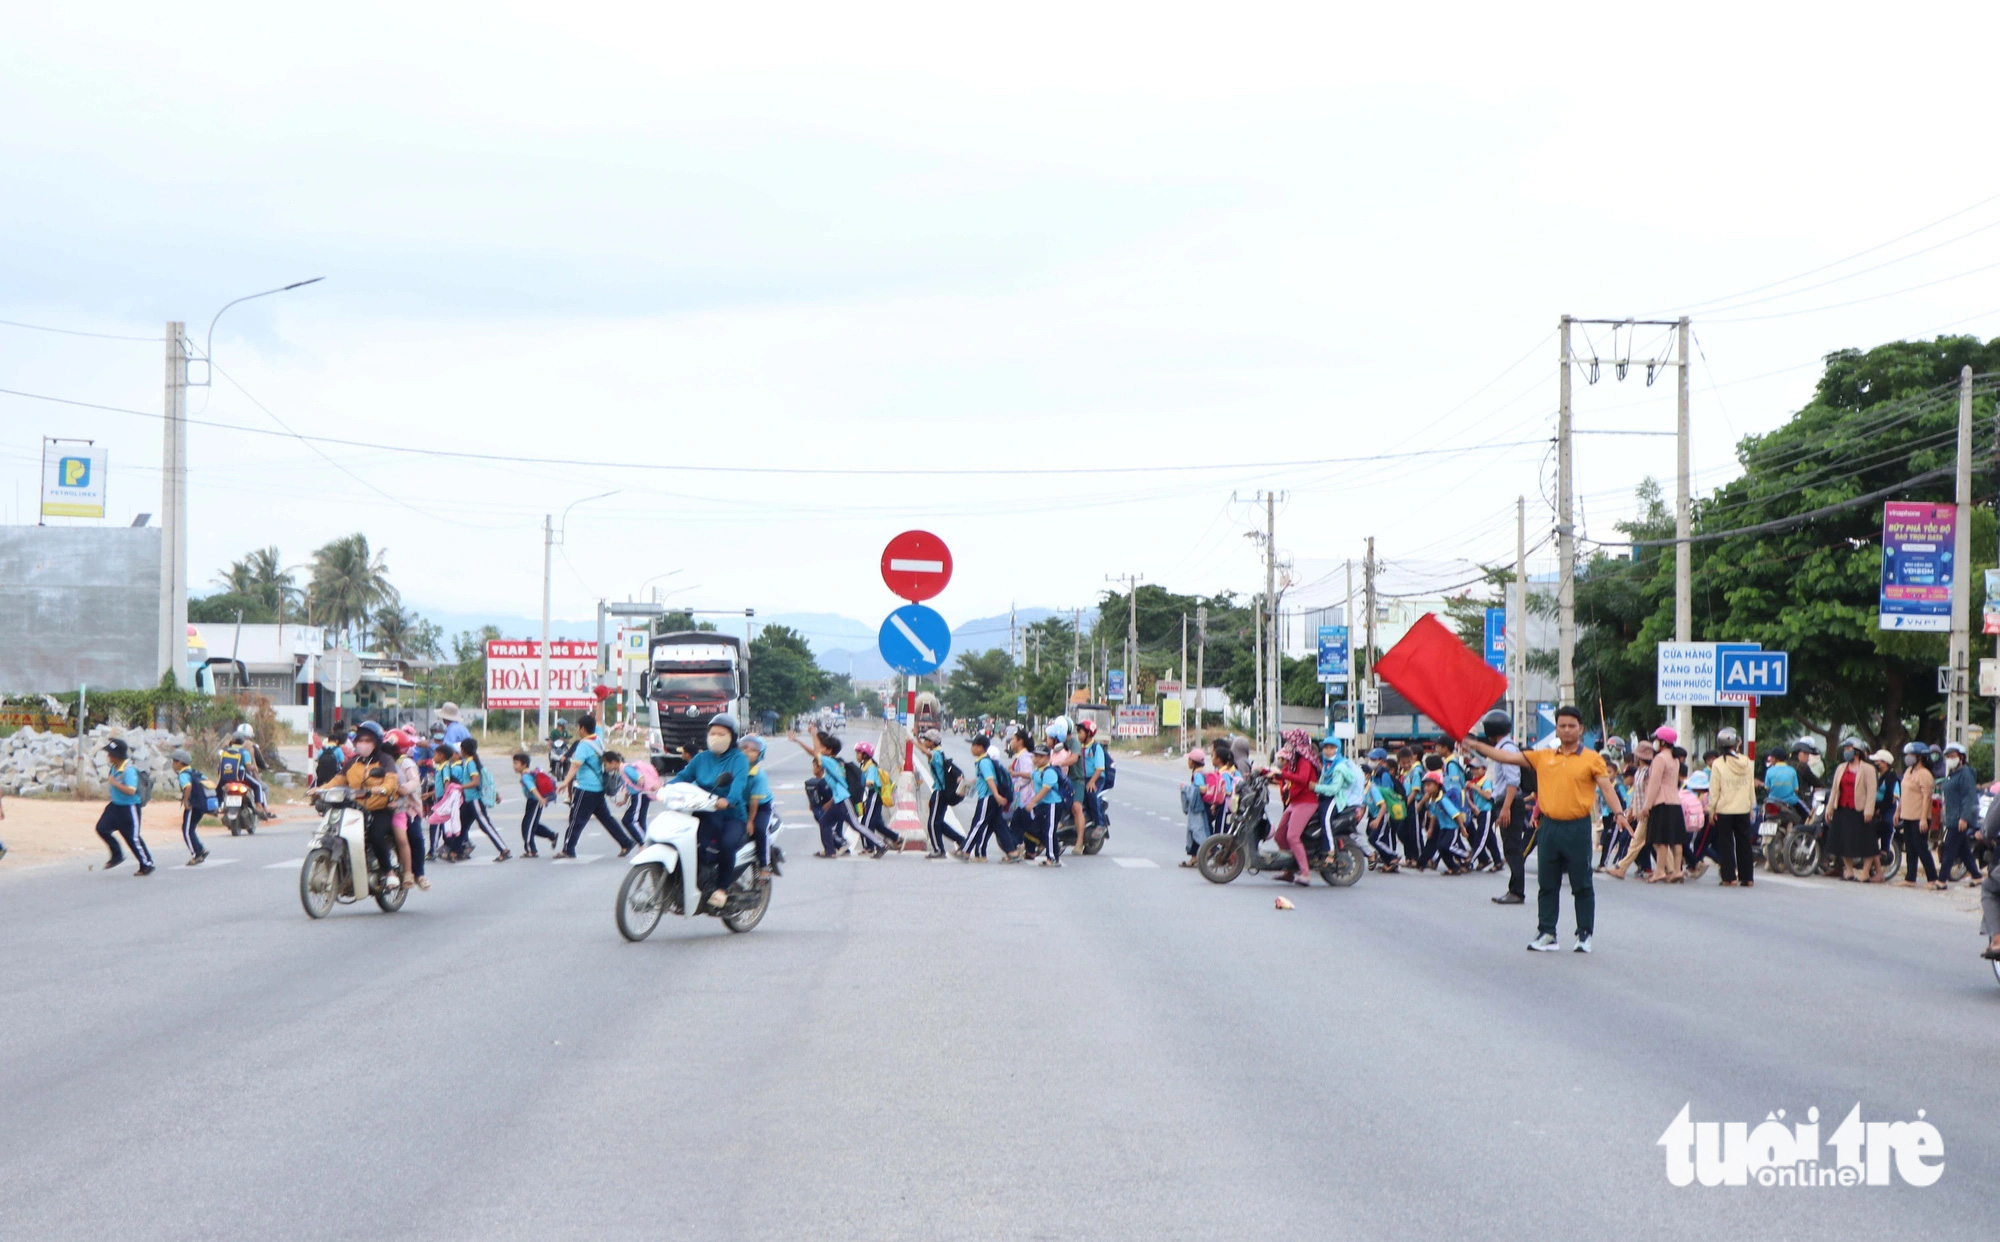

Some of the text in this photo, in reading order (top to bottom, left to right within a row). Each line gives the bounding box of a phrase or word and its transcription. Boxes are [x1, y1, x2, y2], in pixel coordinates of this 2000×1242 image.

[50, 489, 97, 497] PETROLIMEX
[492, 644, 528, 657] TRẠM
[533, 644, 570, 656] XNG
[1663, 647, 1712, 659] CỬA HÀNG
[1663, 662, 1713, 674] XĂNG DẦU
[1727, 660, 1782, 686] AH1
[491, 661, 540, 690] HOÀI
[1662, 679, 1712, 689] NINH PHƯỚC
[1664, 690, 1710, 701] CÁCH 200m
